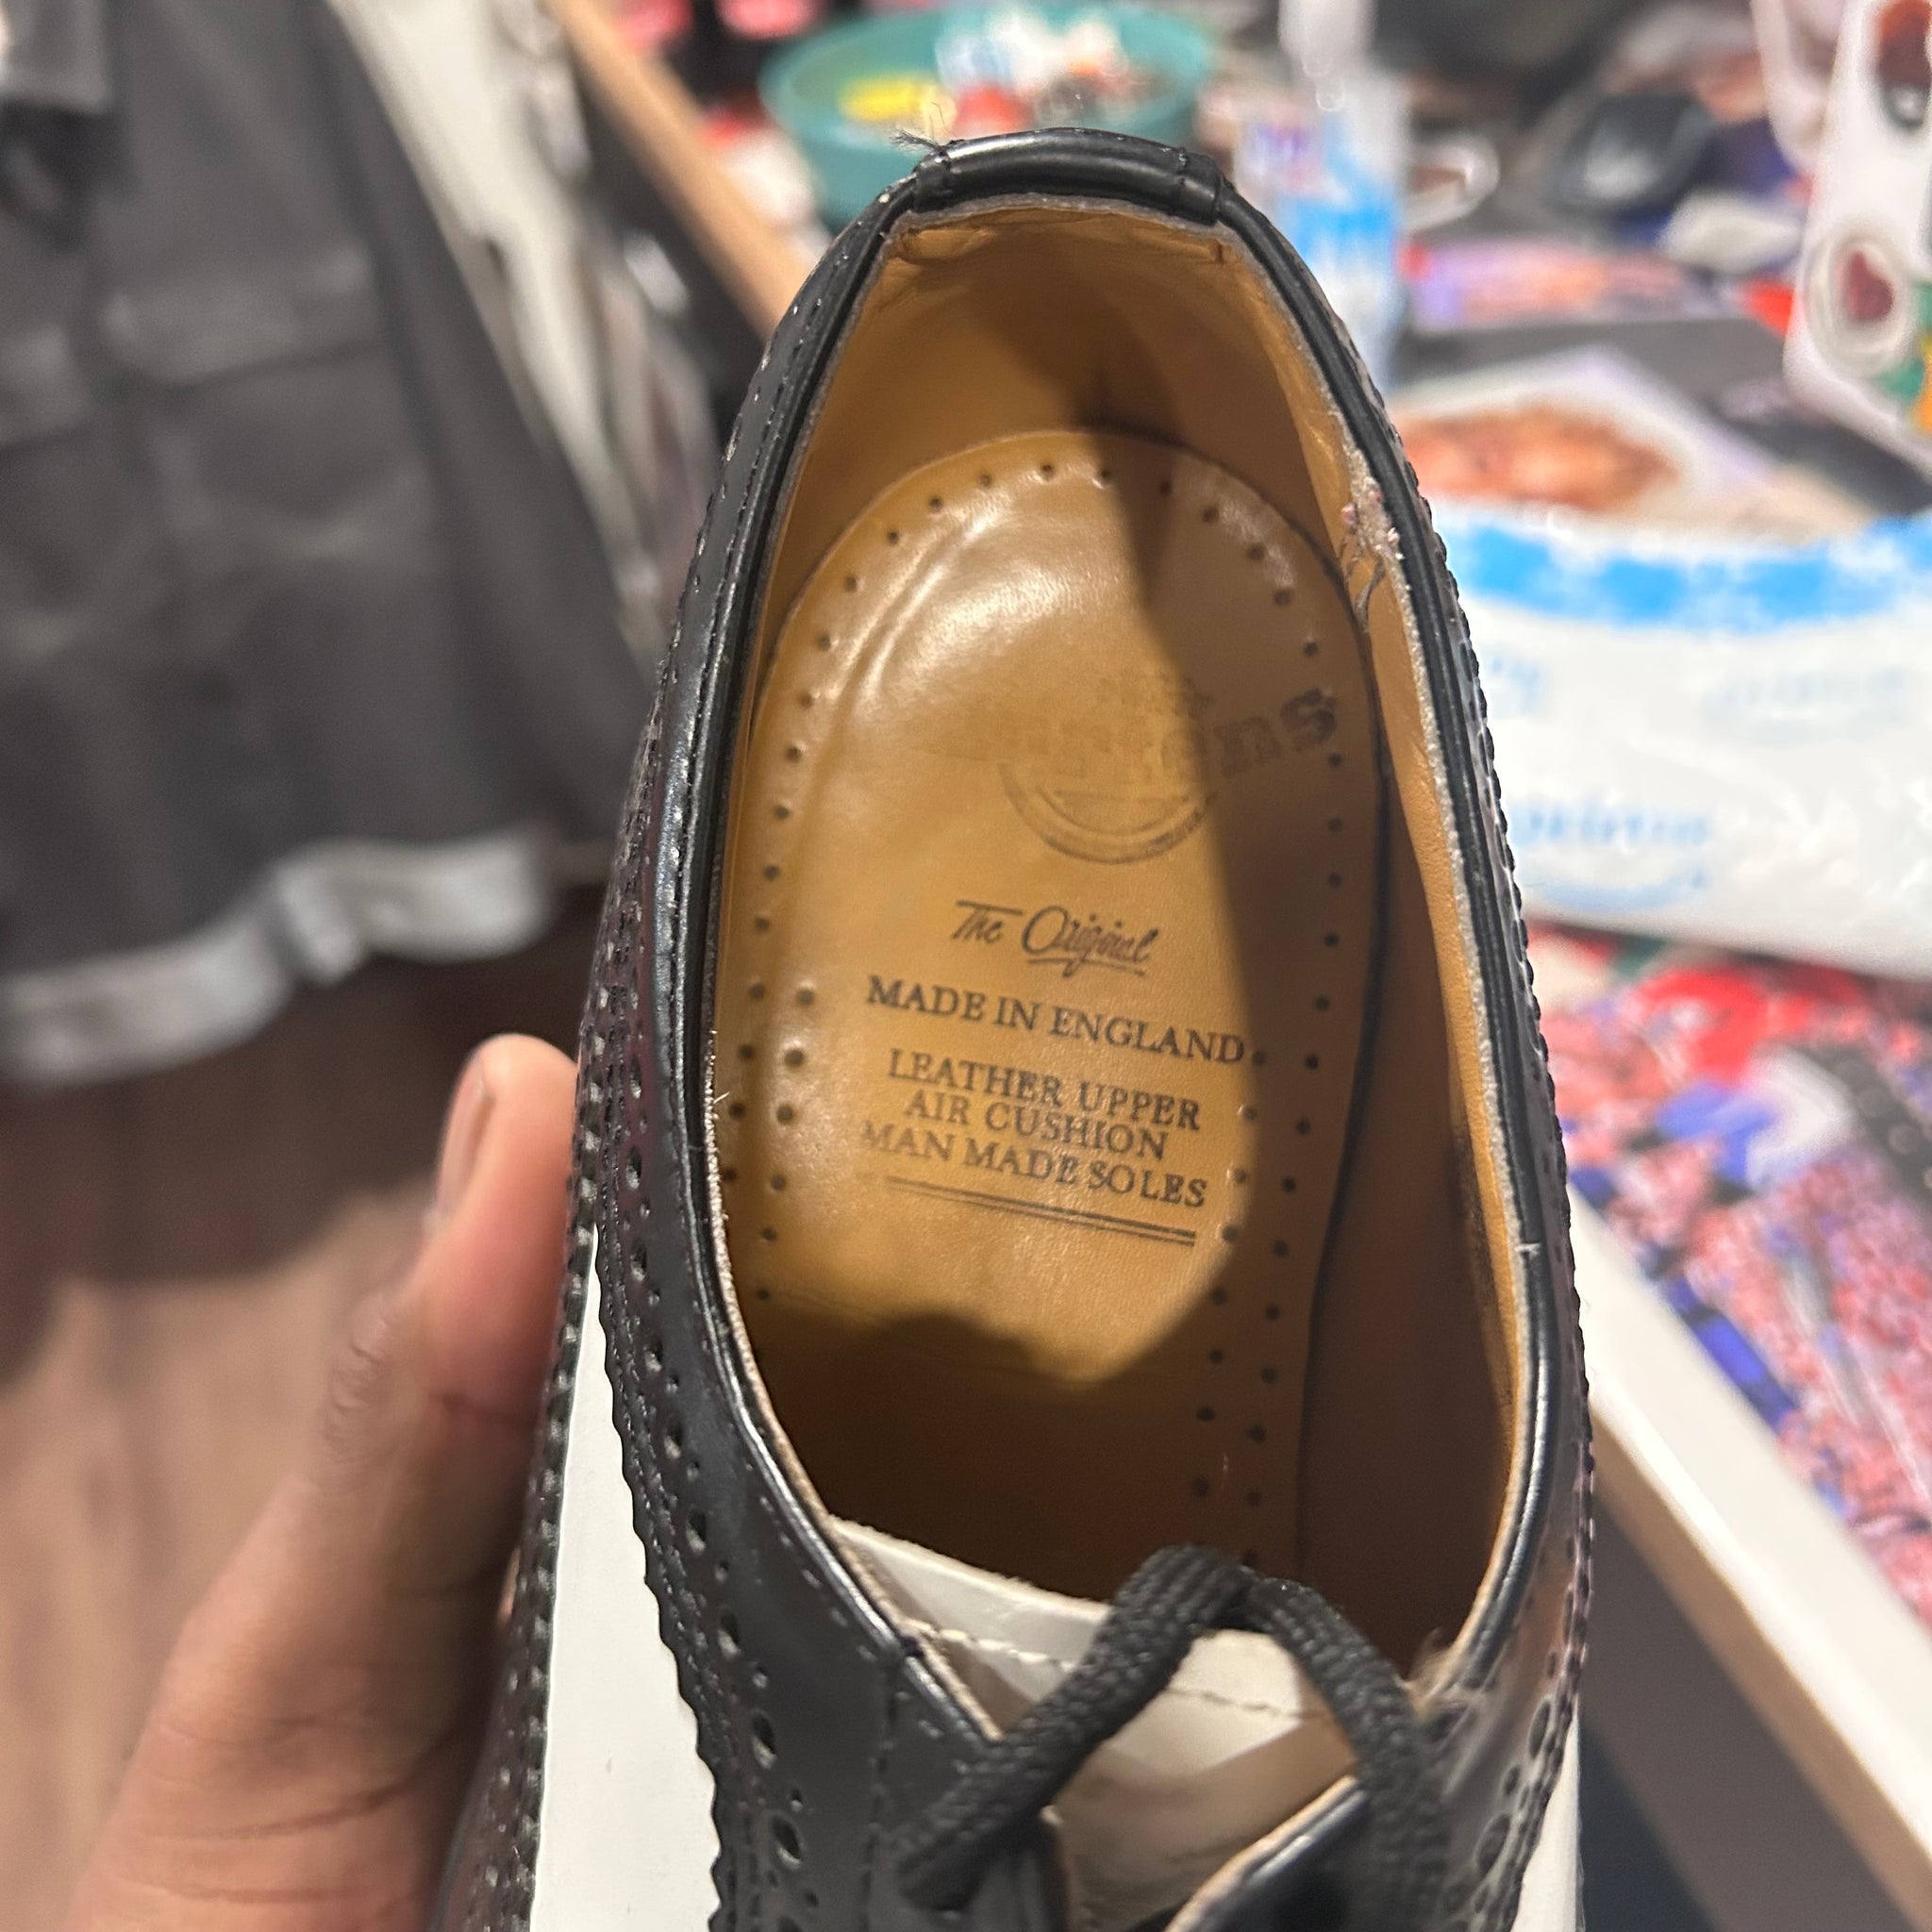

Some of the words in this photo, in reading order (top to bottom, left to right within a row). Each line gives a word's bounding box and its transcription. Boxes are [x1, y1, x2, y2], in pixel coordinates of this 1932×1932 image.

[952, 900, 1023, 943] The
[1022, 906, 1158, 978] Original
[866, 974, 984, 1022] MADE
[996, 998, 1042, 1031] IN
[1049, 1006, 1246, 1064] ENGLAND
[889, 1048, 1064, 1108] LEATHER
[1078, 1081, 1201, 1131] UPPER
[904, 1089, 973, 1125] AIR
[985, 1102, 1169, 1161] CUSHION
[861, 1121, 956, 1161] MAN
[961, 1138, 1082, 1186] MADE
[1087, 1155, 1208, 1208] SOLES
